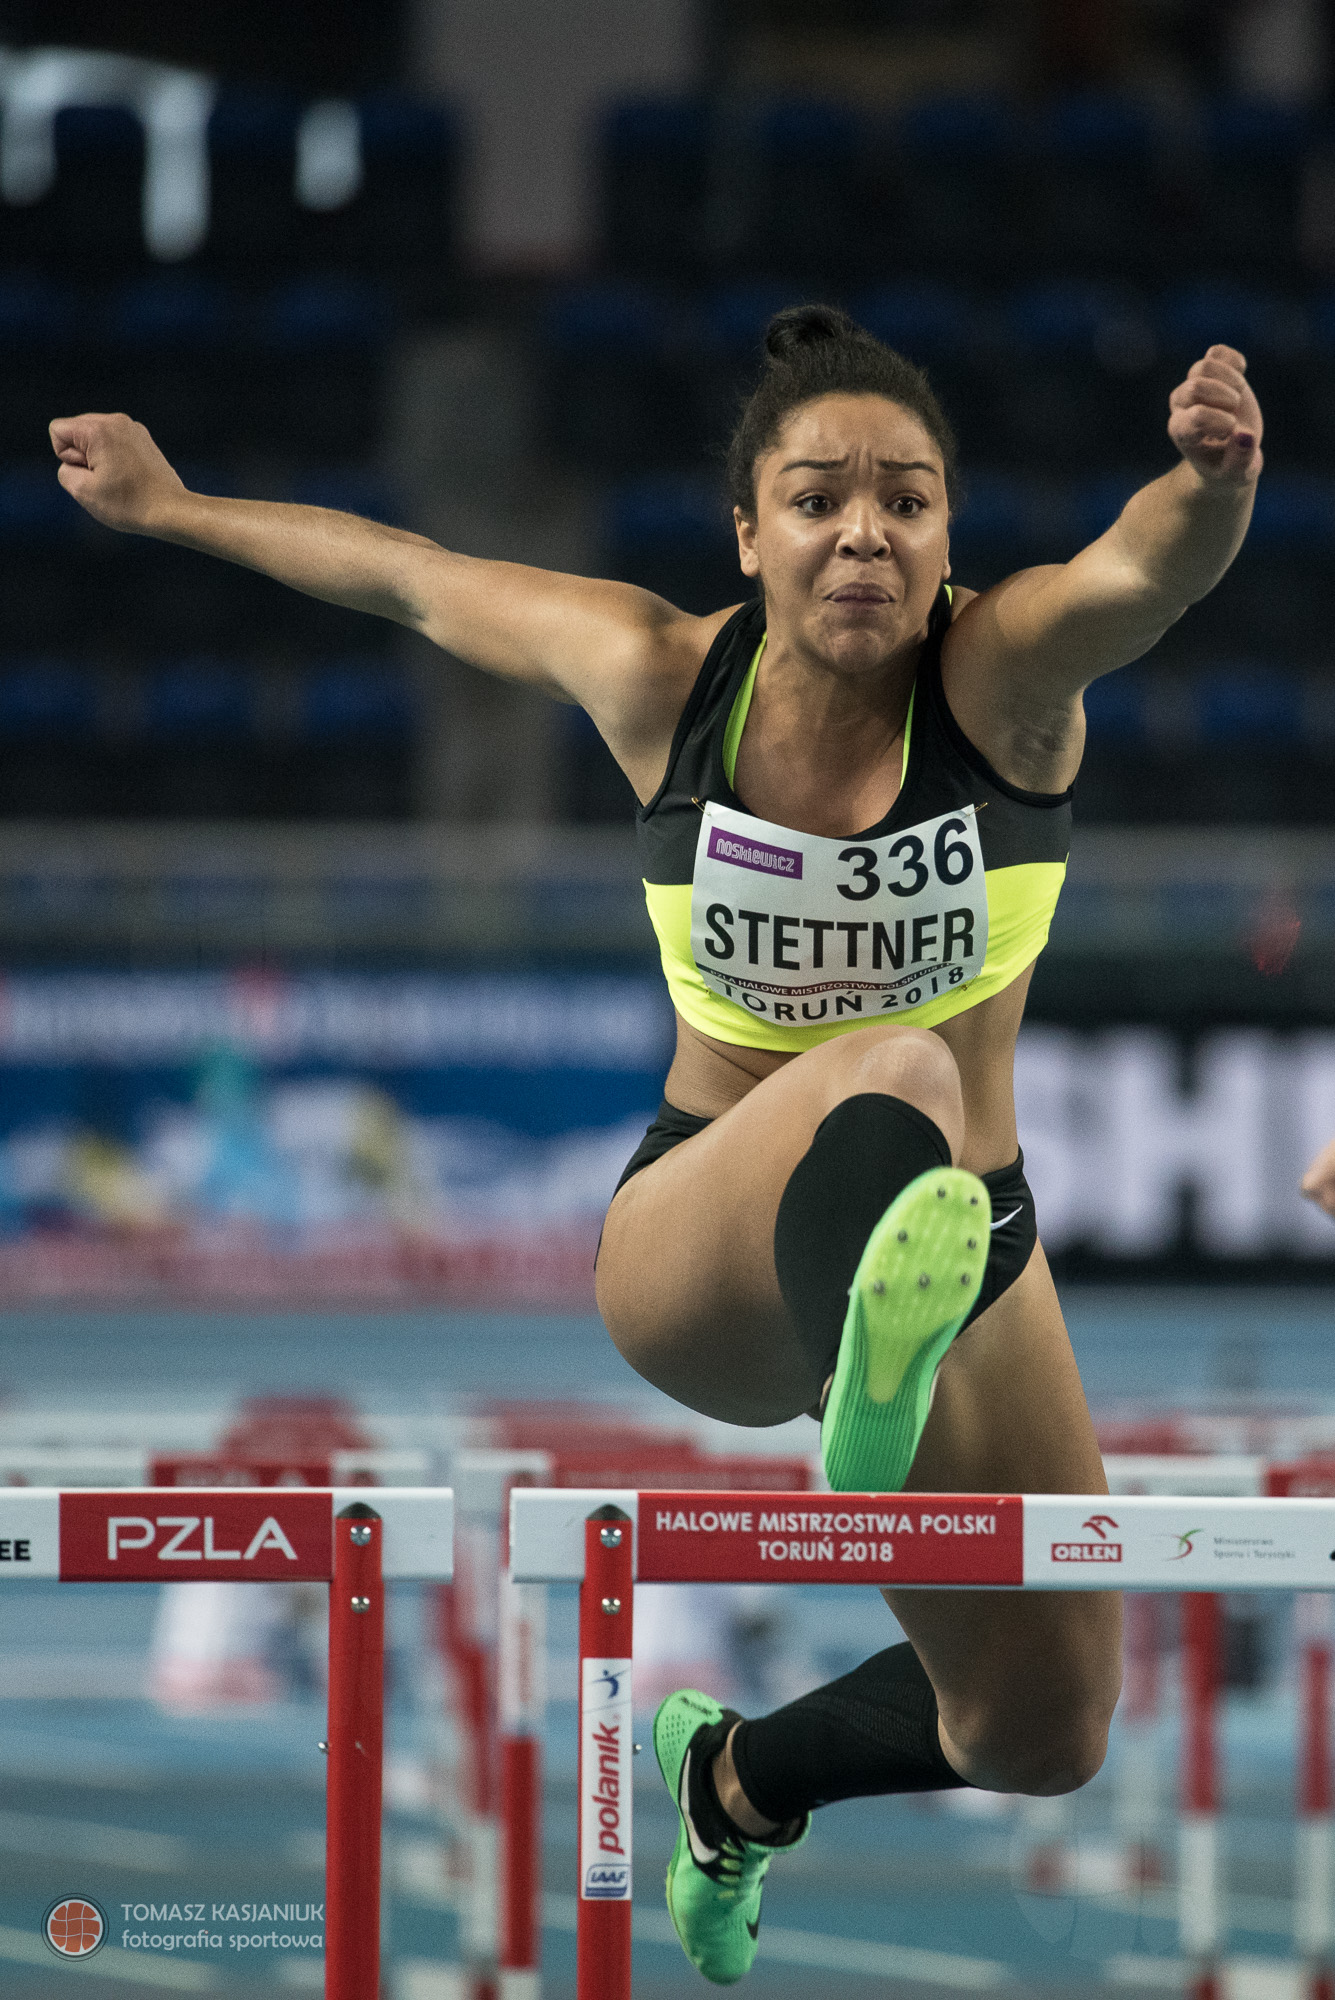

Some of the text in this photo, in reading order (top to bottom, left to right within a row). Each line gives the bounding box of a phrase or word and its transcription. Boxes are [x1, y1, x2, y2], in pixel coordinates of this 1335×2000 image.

[836, 818, 974, 901] 336
[704, 902, 975, 971] STETTNER
[715, 966, 964, 1021] TORUŃ 2018
[738, 980, 788, 995] HALOWE
[790, 981, 877, 996] MISTRZOSTWA
[879, 974, 917, 990] POLSKI
[107, 1516, 298, 1561] PZLA
[656, 1511, 996, 1535] HALOWE MISTRZOSTWA POLSKI
[758, 1536, 894, 1562] TORUŃ 2018
[1053, 1545, 1120, 1561] ORLEN
[592, 1721, 626, 1856] polanik
